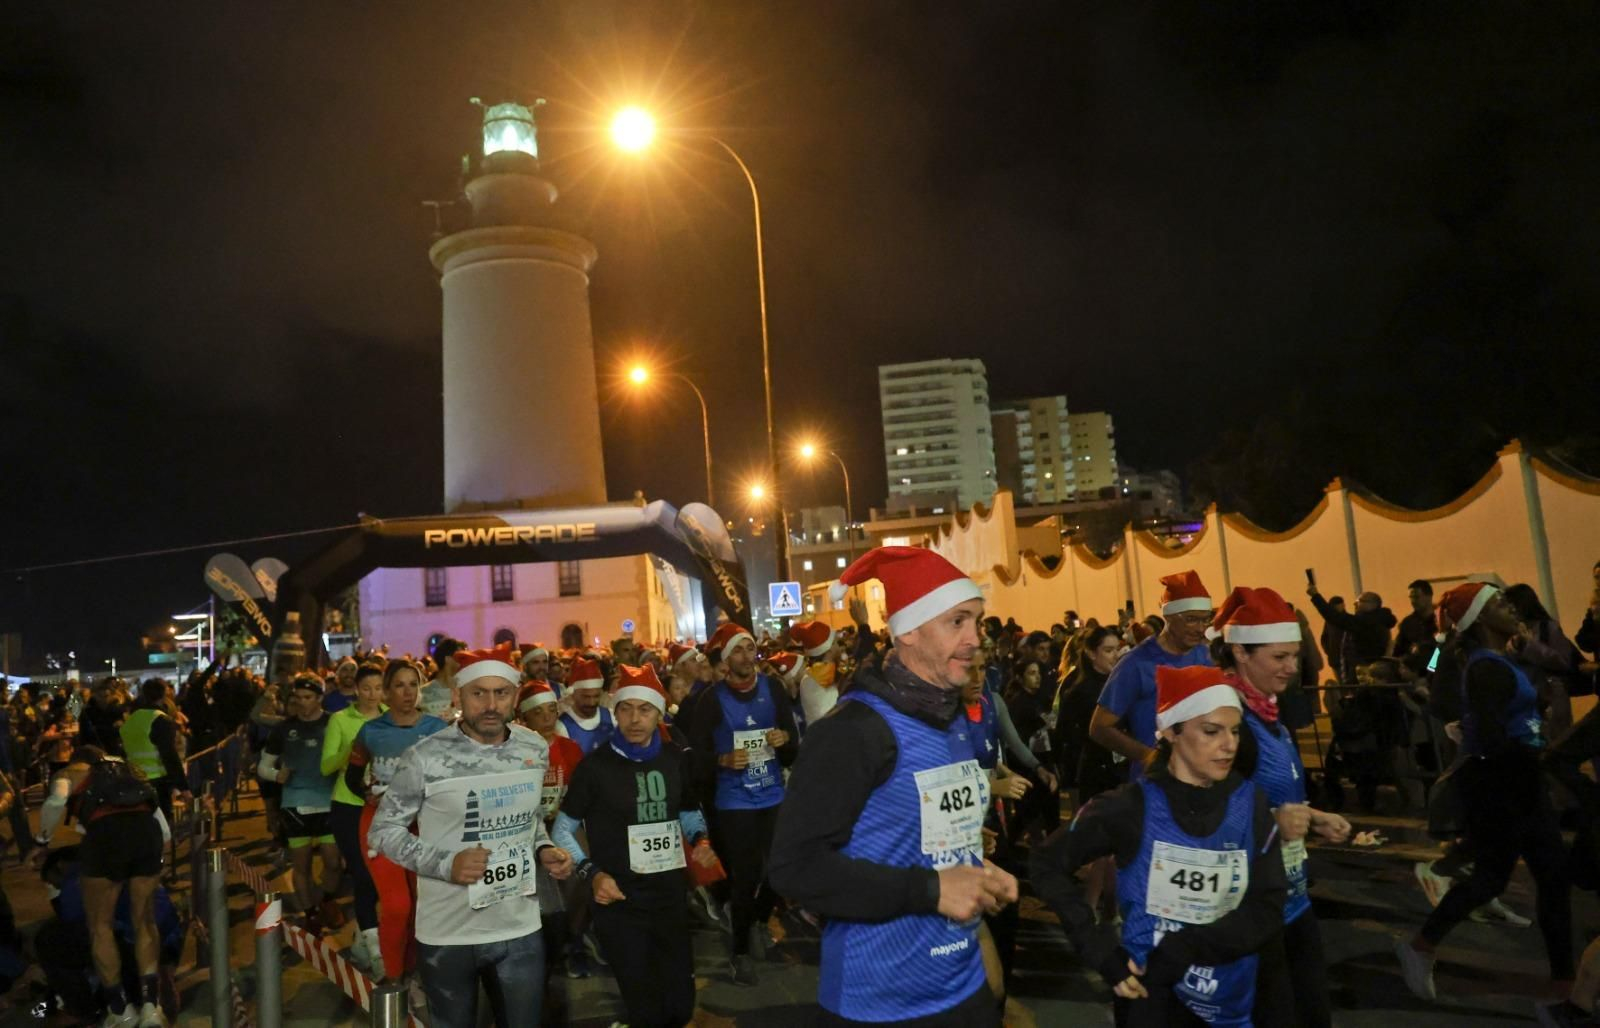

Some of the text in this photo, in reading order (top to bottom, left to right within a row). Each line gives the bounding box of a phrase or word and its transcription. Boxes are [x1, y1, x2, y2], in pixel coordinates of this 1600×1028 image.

[424, 522, 597, 549] POWERADE
[743, 739, 764, 750] 557
[747, 765, 769, 777] RCM
[480, 782, 535, 800] SAN SILVESTRE
[939, 785, 975, 814] 482
[642, 836, 671, 853] 356
[483, 863, 518, 886] 868
[1169, 868, 1220, 893] 481
[930, 938, 969, 958] mayoral
